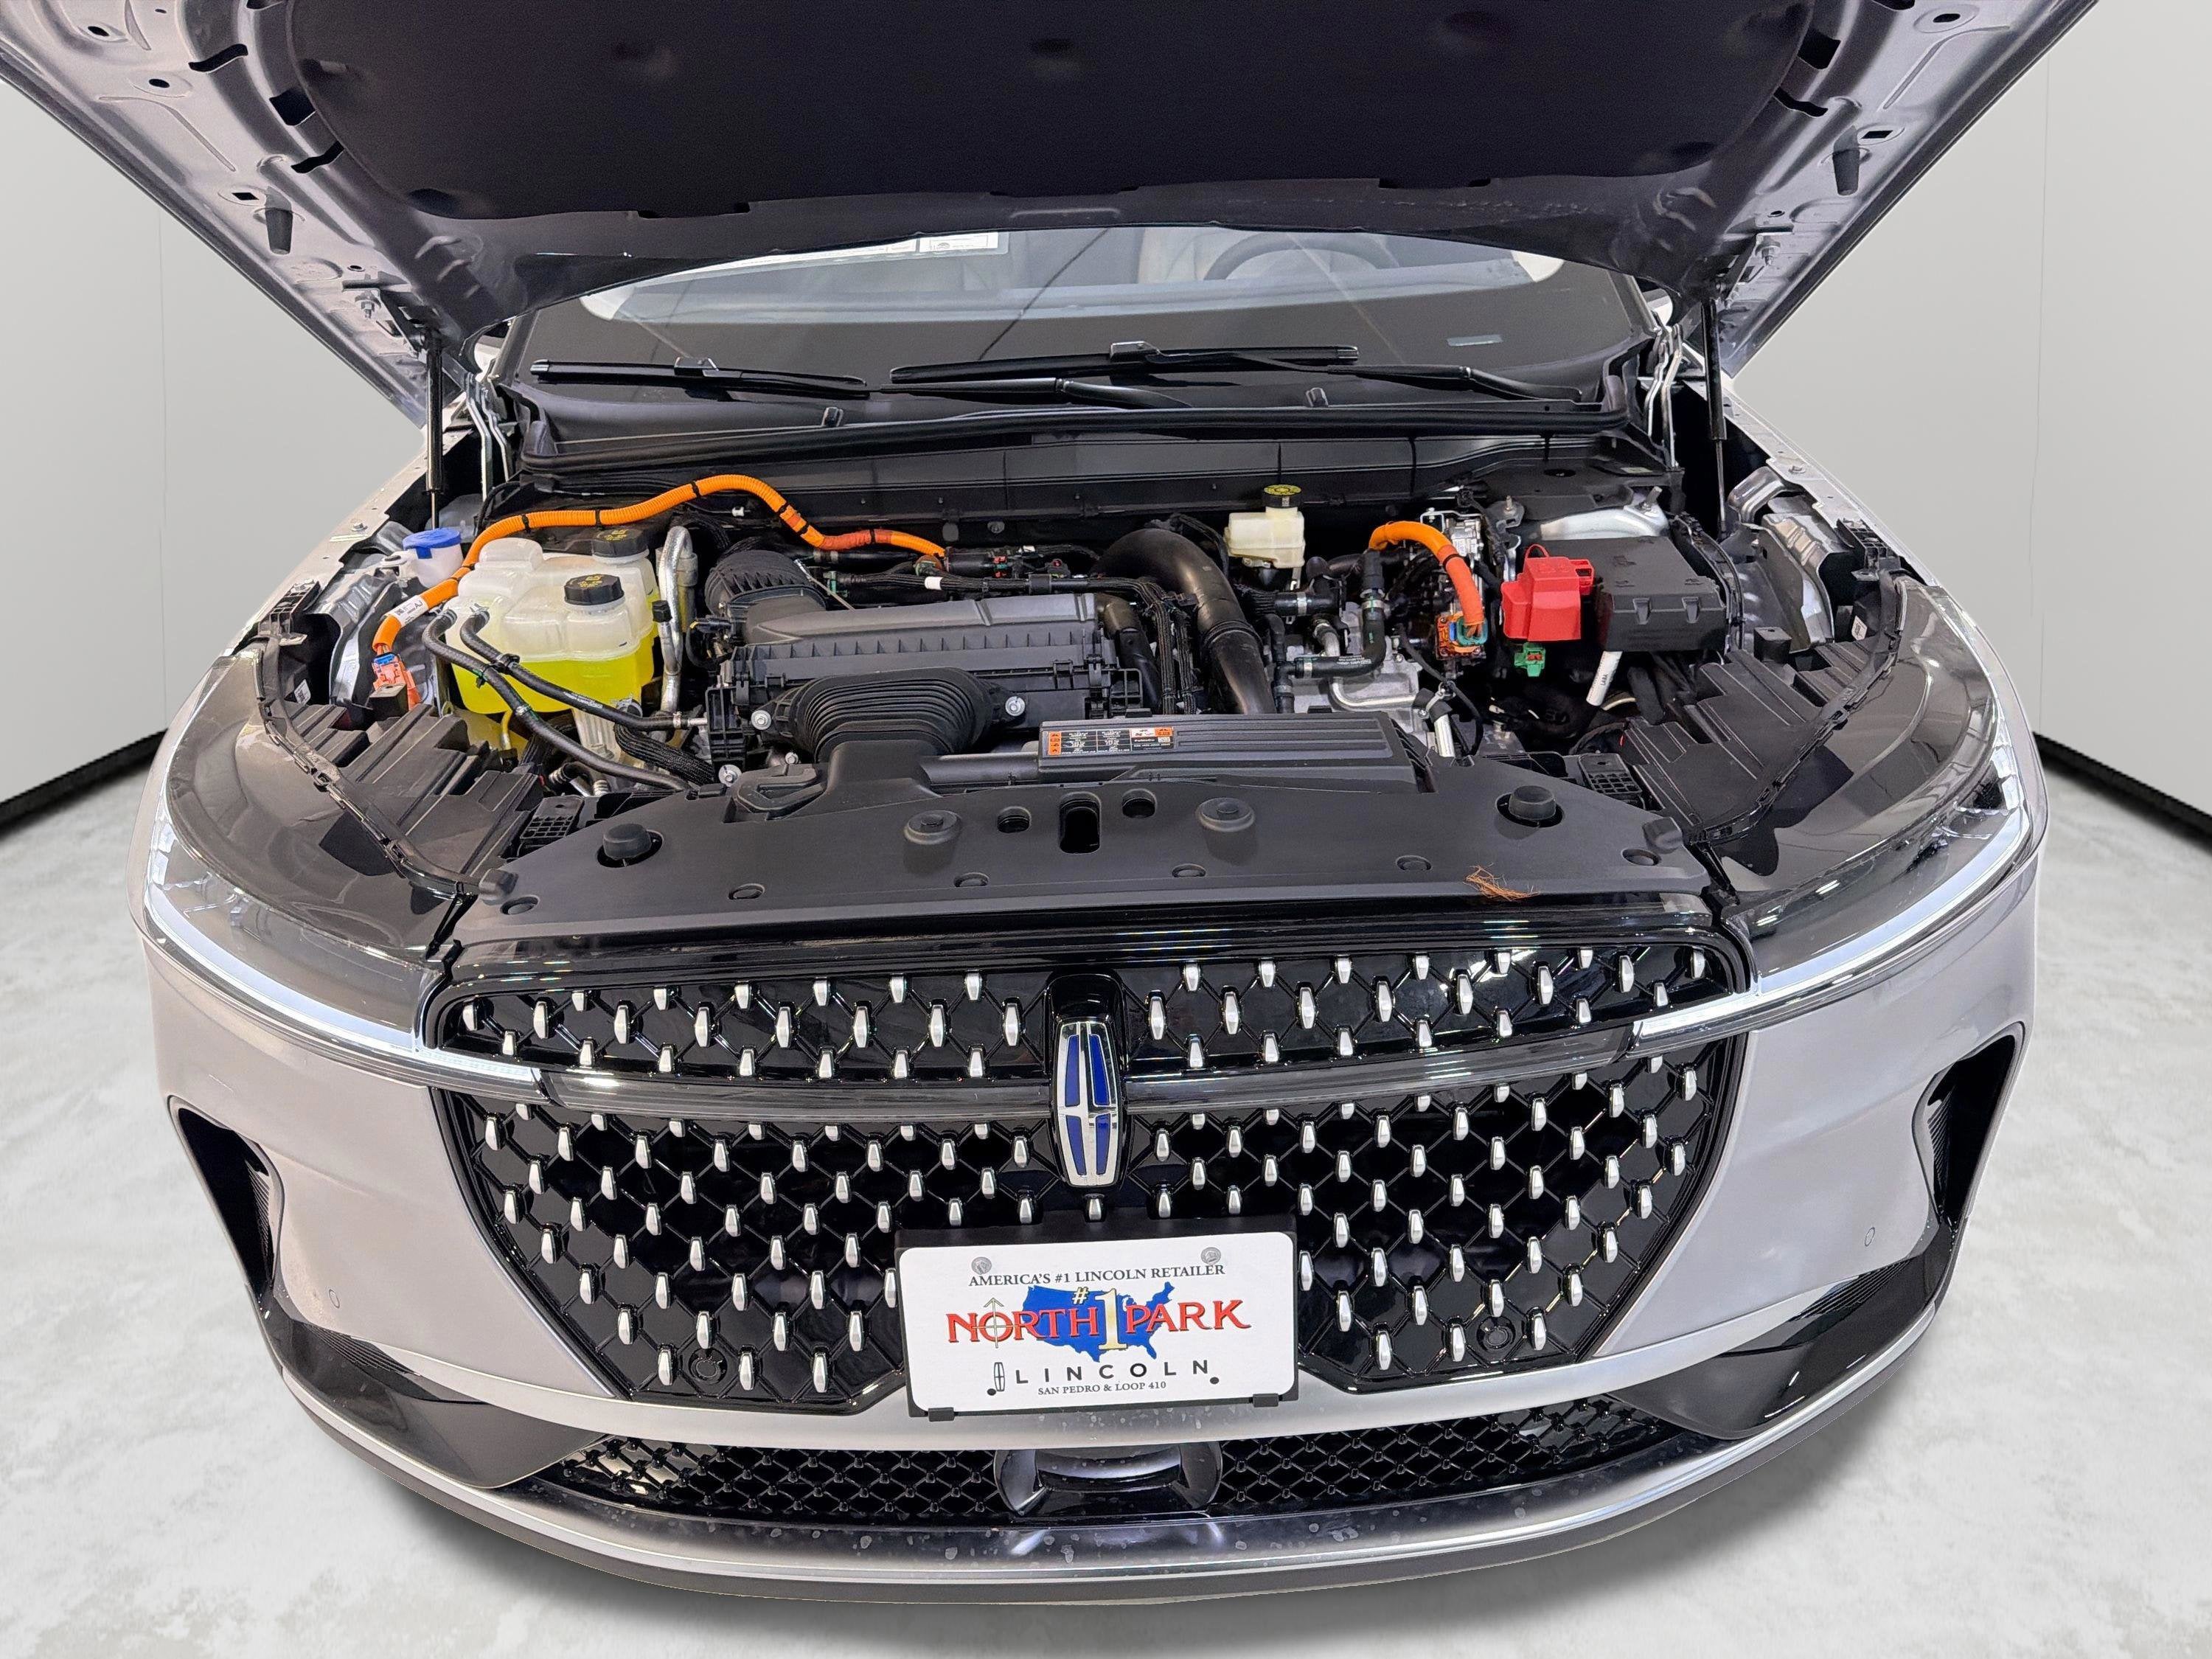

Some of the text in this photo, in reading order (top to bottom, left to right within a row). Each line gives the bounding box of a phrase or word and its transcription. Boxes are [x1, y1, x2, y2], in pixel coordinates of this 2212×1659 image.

[968, 1264, 1225, 1287] AMERICA'S #1 LINCOLN RETAILER
[946, 1299, 1253, 1343] NORTH PARK
[1015, 1360, 1208, 1384] LINCOLN
[1037, 1381, 1166, 1395] SAN PEDRO & LOOP 410
